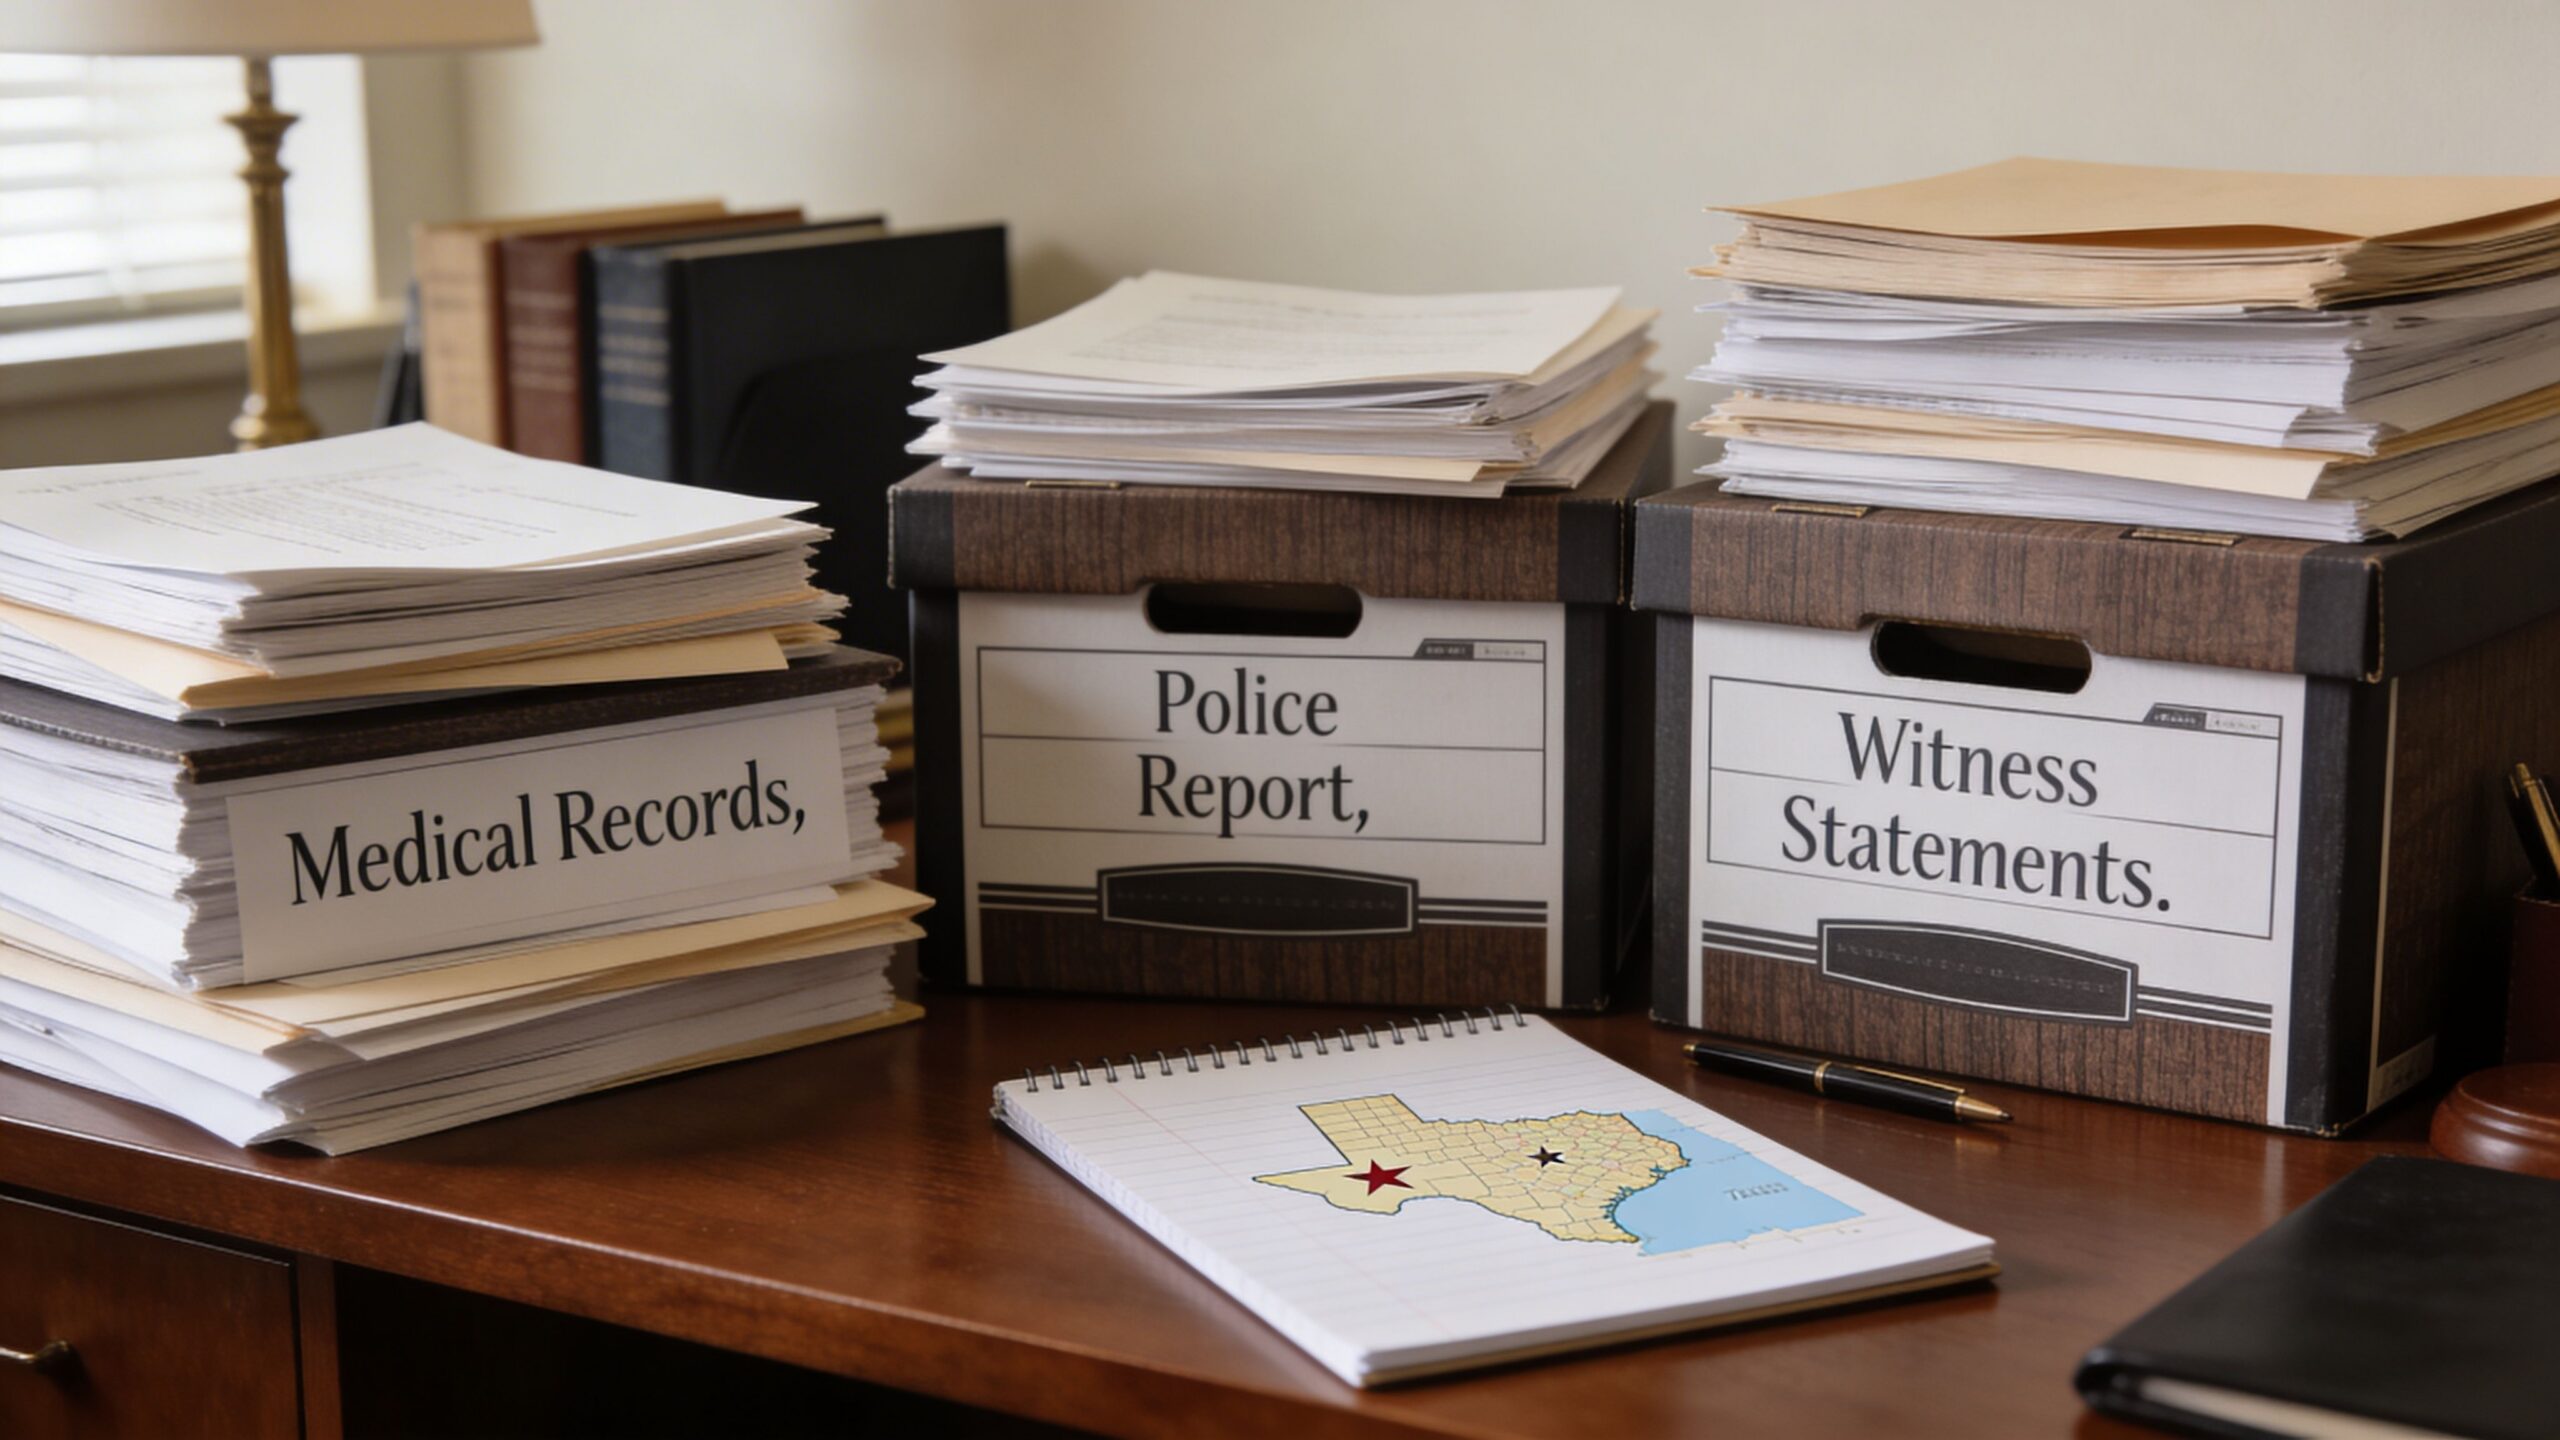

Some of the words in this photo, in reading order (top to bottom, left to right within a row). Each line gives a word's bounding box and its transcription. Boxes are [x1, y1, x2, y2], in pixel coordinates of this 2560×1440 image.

[1155, 666, 1338, 738] Police
[1136, 753, 1370, 838] Report,
[1838, 711, 2098, 807] Witness
[284, 793, 538, 907] Medical
[552, 759, 808, 862] Records,
[1781, 795, 2171, 912] Statements.
